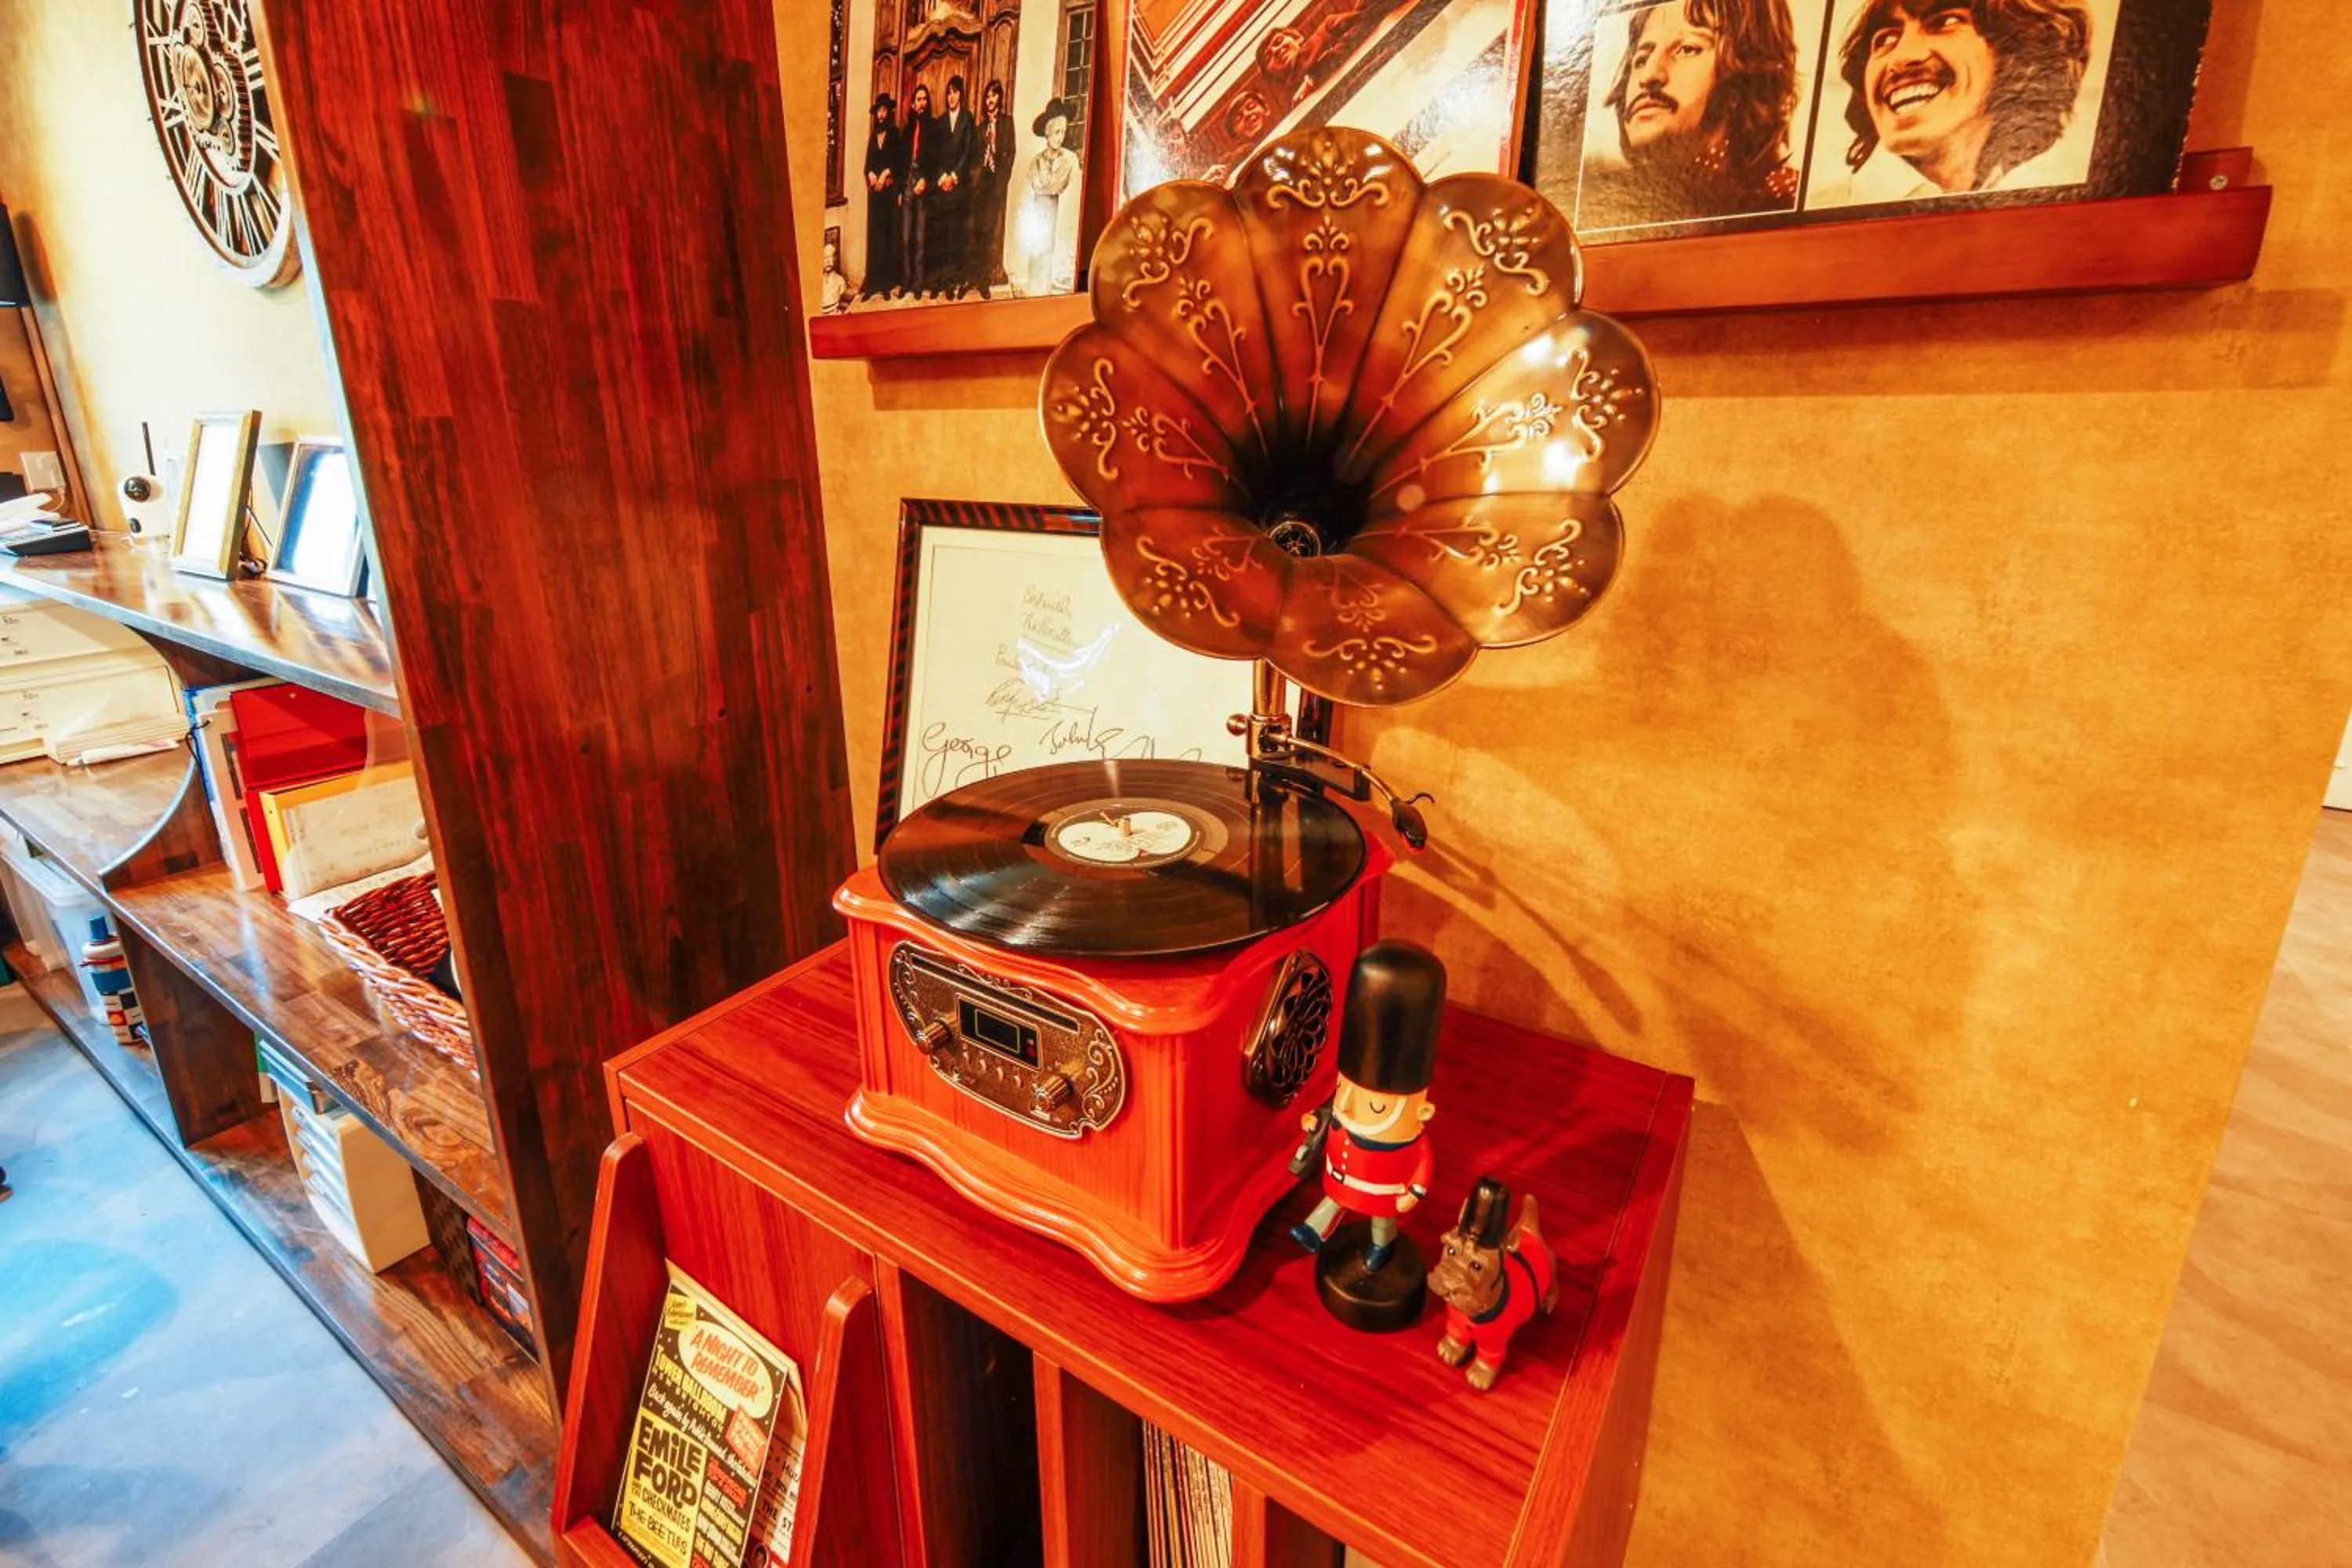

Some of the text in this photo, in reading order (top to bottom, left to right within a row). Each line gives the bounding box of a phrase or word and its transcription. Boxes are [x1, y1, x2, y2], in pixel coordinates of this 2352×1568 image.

[922, 721, 1013, 799] George
[691, 1350, 760, 1403] REMEMBER
[702, 1333, 744, 1368] NIGHT
[742, 1354, 759, 1377] TO
[633, 1455, 699, 1510] FORD
[628, 1500, 648, 1525] THE
